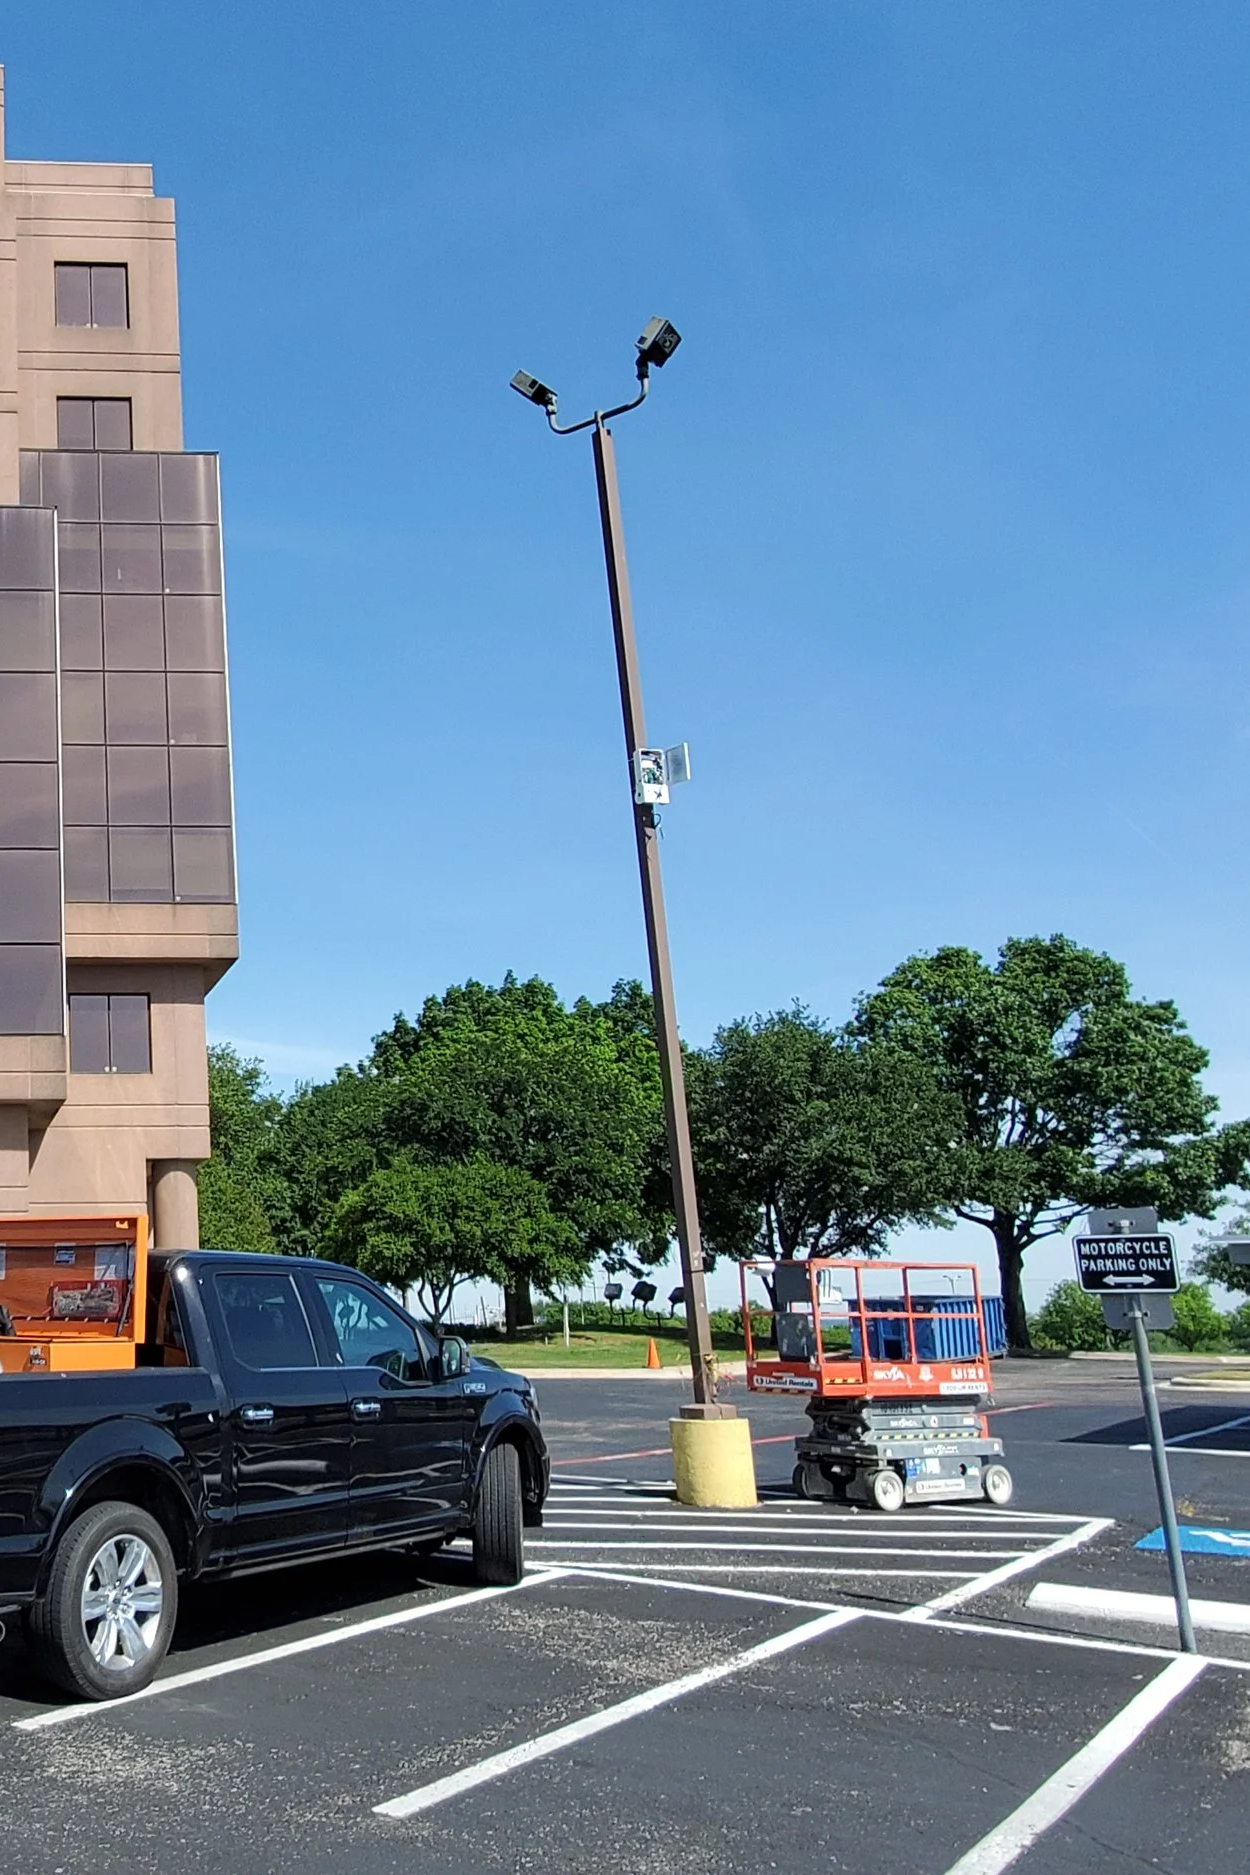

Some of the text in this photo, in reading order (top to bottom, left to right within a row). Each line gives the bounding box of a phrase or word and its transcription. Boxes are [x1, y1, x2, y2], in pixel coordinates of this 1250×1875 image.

[1080, 1241, 1168, 1255] MOTORCYCLE
[1081, 1258, 1171, 1272] PARKING ONLY
